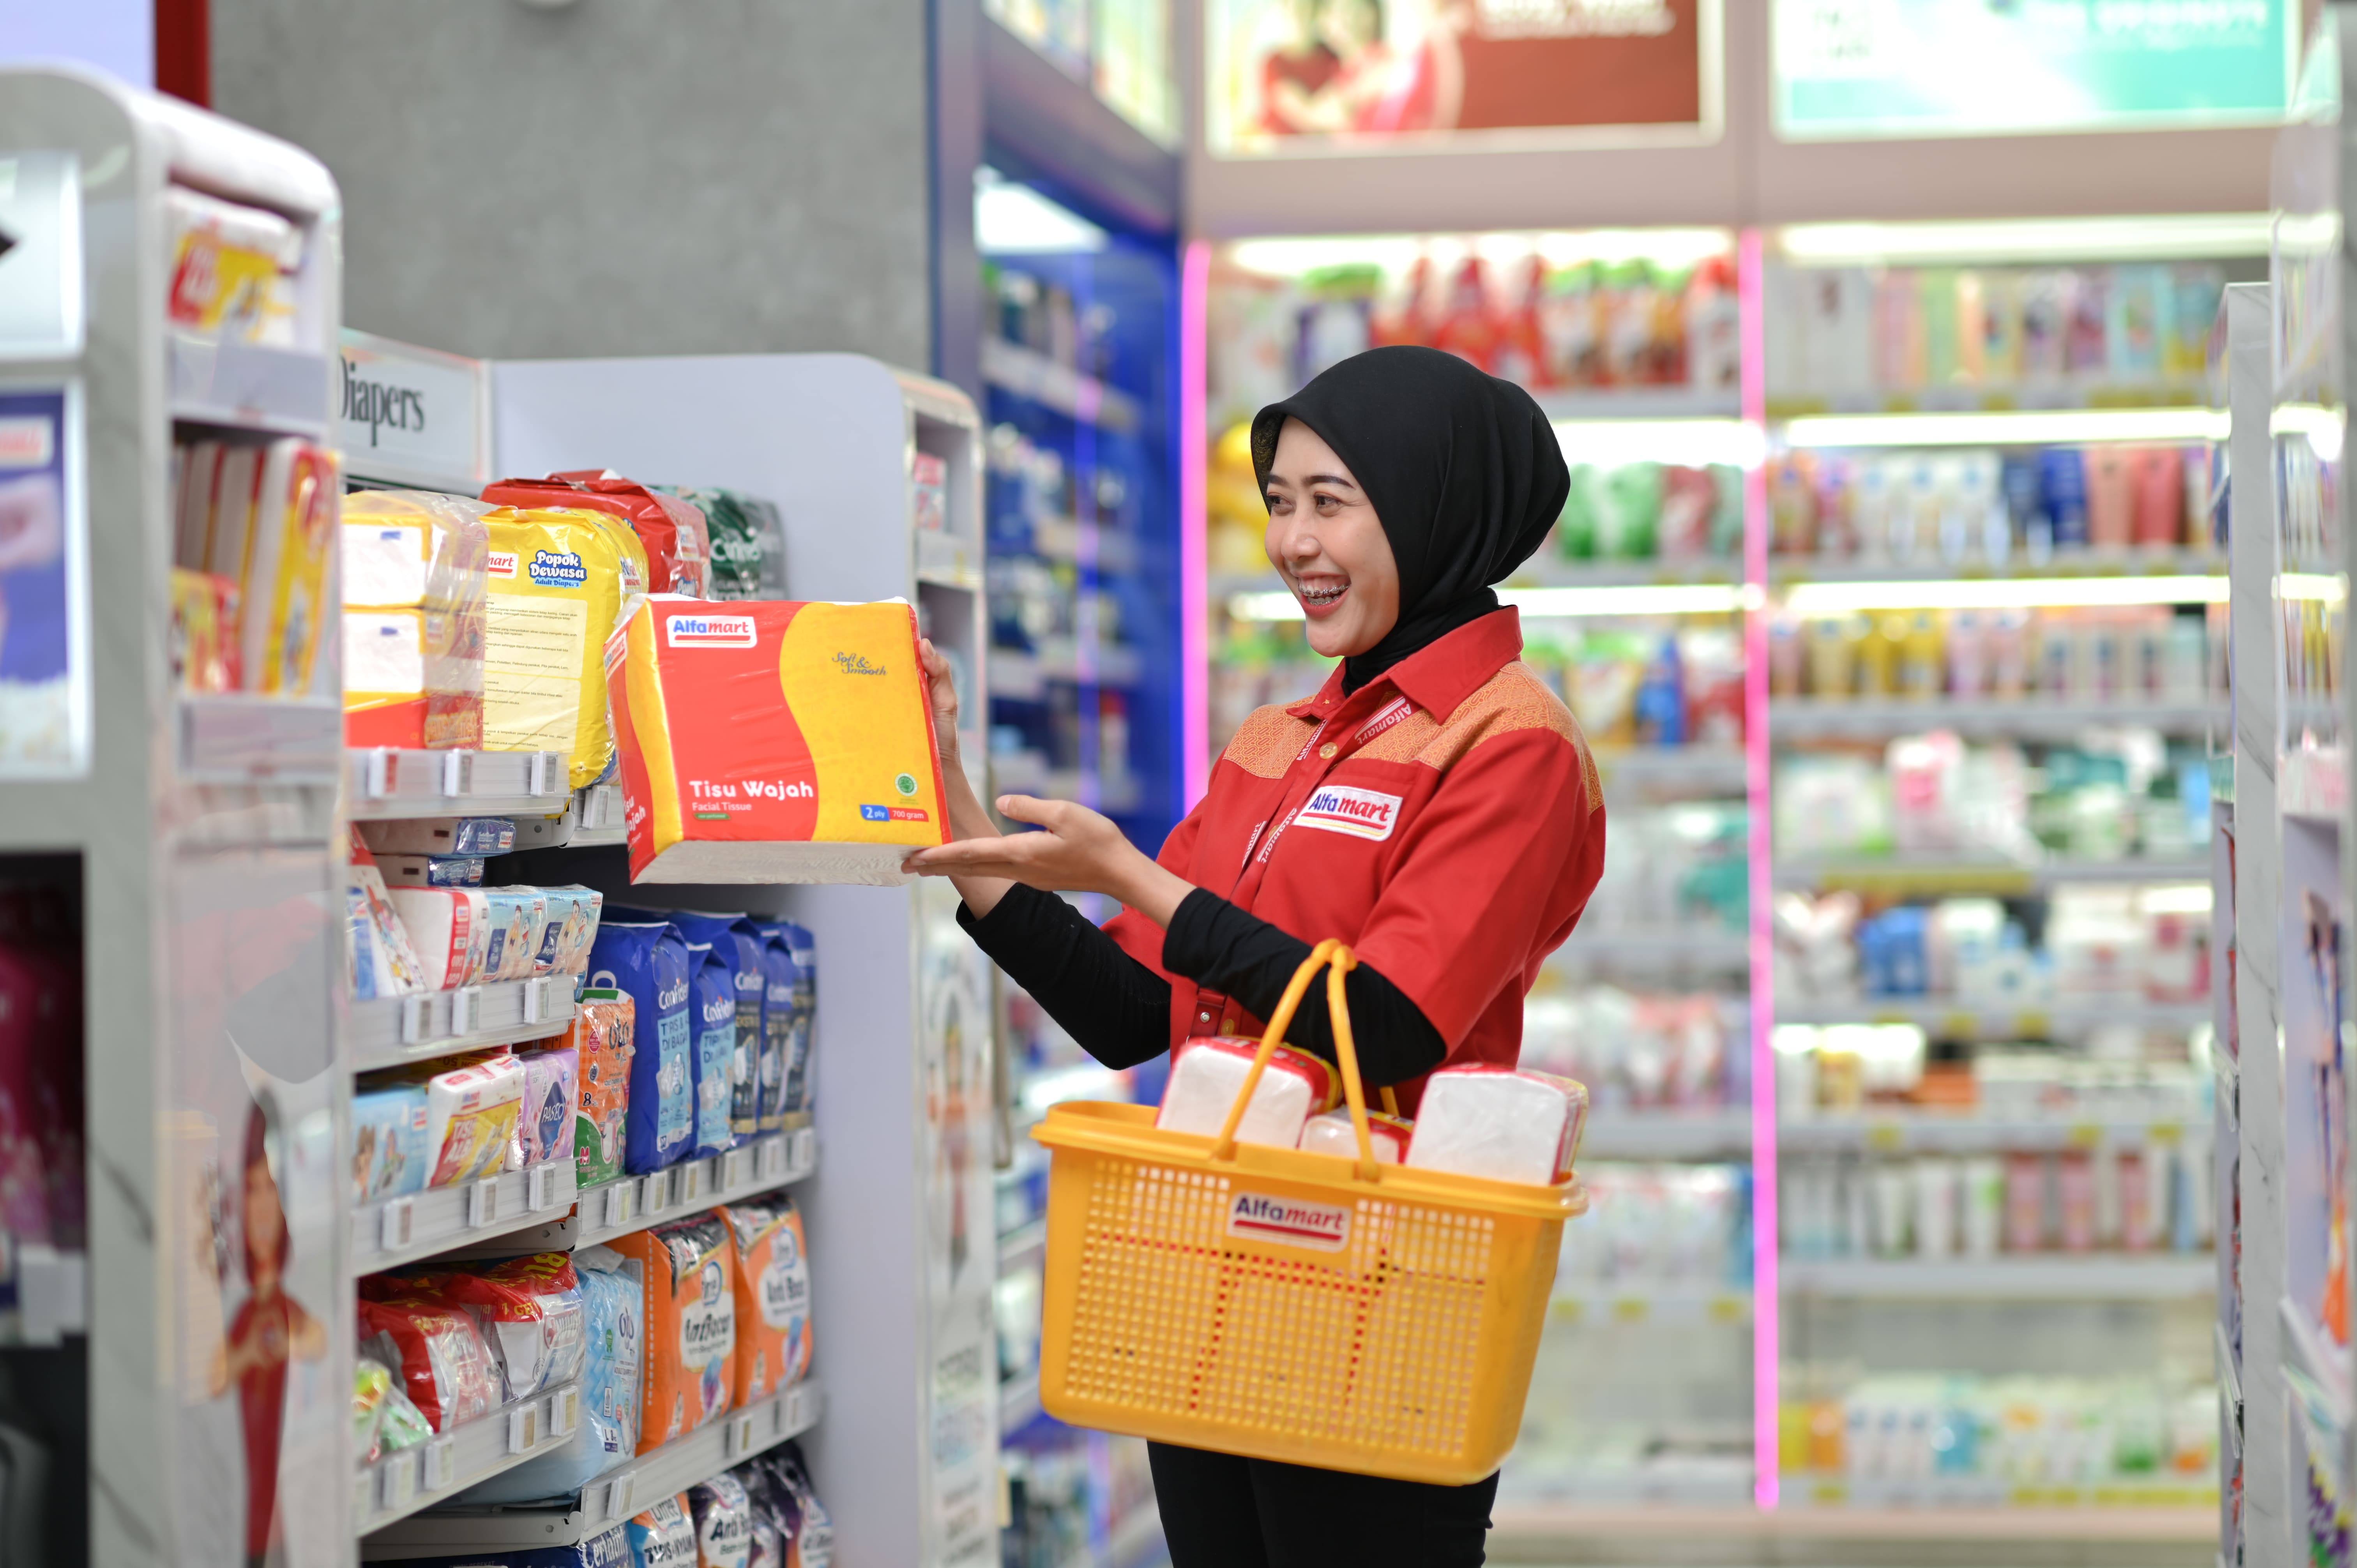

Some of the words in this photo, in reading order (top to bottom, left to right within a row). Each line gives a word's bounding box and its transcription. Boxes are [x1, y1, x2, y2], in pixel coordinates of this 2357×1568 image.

[537, 551, 579, 567] Popok
[530, 563, 585, 579] Dewasa
[673, 620, 749, 633] Alfamart
[832, 652, 857, 666] Soft
[857, 657, 872, 668] &
[842, 663, 887, 676] Smooth
[1357, 703, 1412, 745] Alfamart
[689, 780, 737, 798] Tisu
[742, 780, 814, 801] Wajah
[692, 802, 720, 811] Facial
[721, 802, 752, 811] Tissue
[865, 807, 873, 818] 2
[1308, 793, 1392, 822] Alfamart
[583, 1092, 592, 1106] 8
[541, 1103, 565, 1124] PASEO
[1235, 1196, 1344, 1230] Alfamart
